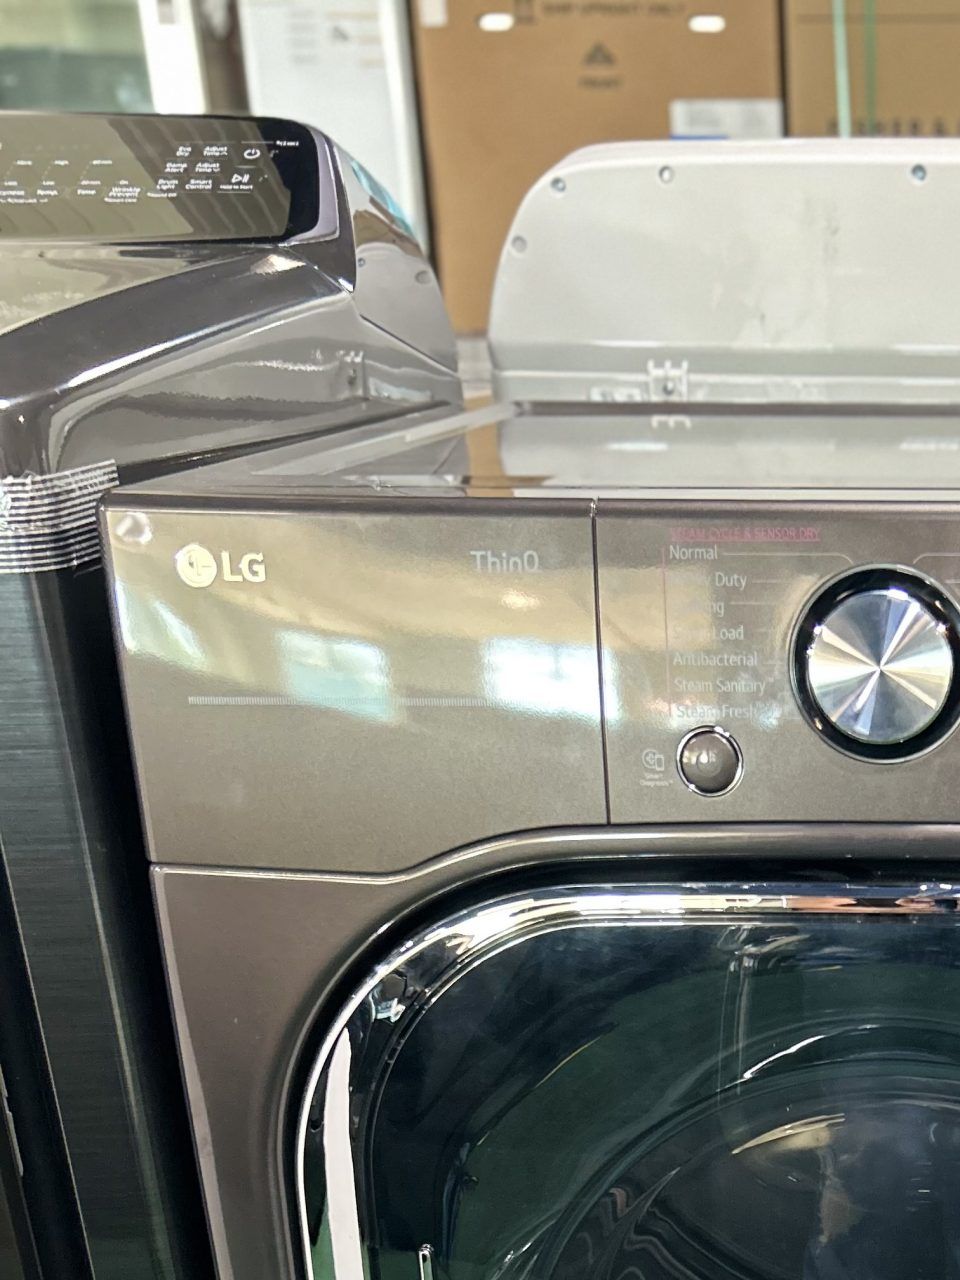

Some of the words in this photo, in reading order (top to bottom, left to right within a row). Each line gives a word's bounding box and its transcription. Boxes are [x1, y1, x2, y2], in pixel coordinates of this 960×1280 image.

[800, 527, 820, 541] DRY
[669, 545, 718, 560] Normal
[220, 550, 266, 583] LG
[715, 571, 748, 591] Duty
[672, 651, 758, 667] Antibacterial
[674, 678, 713, 692] Steam
